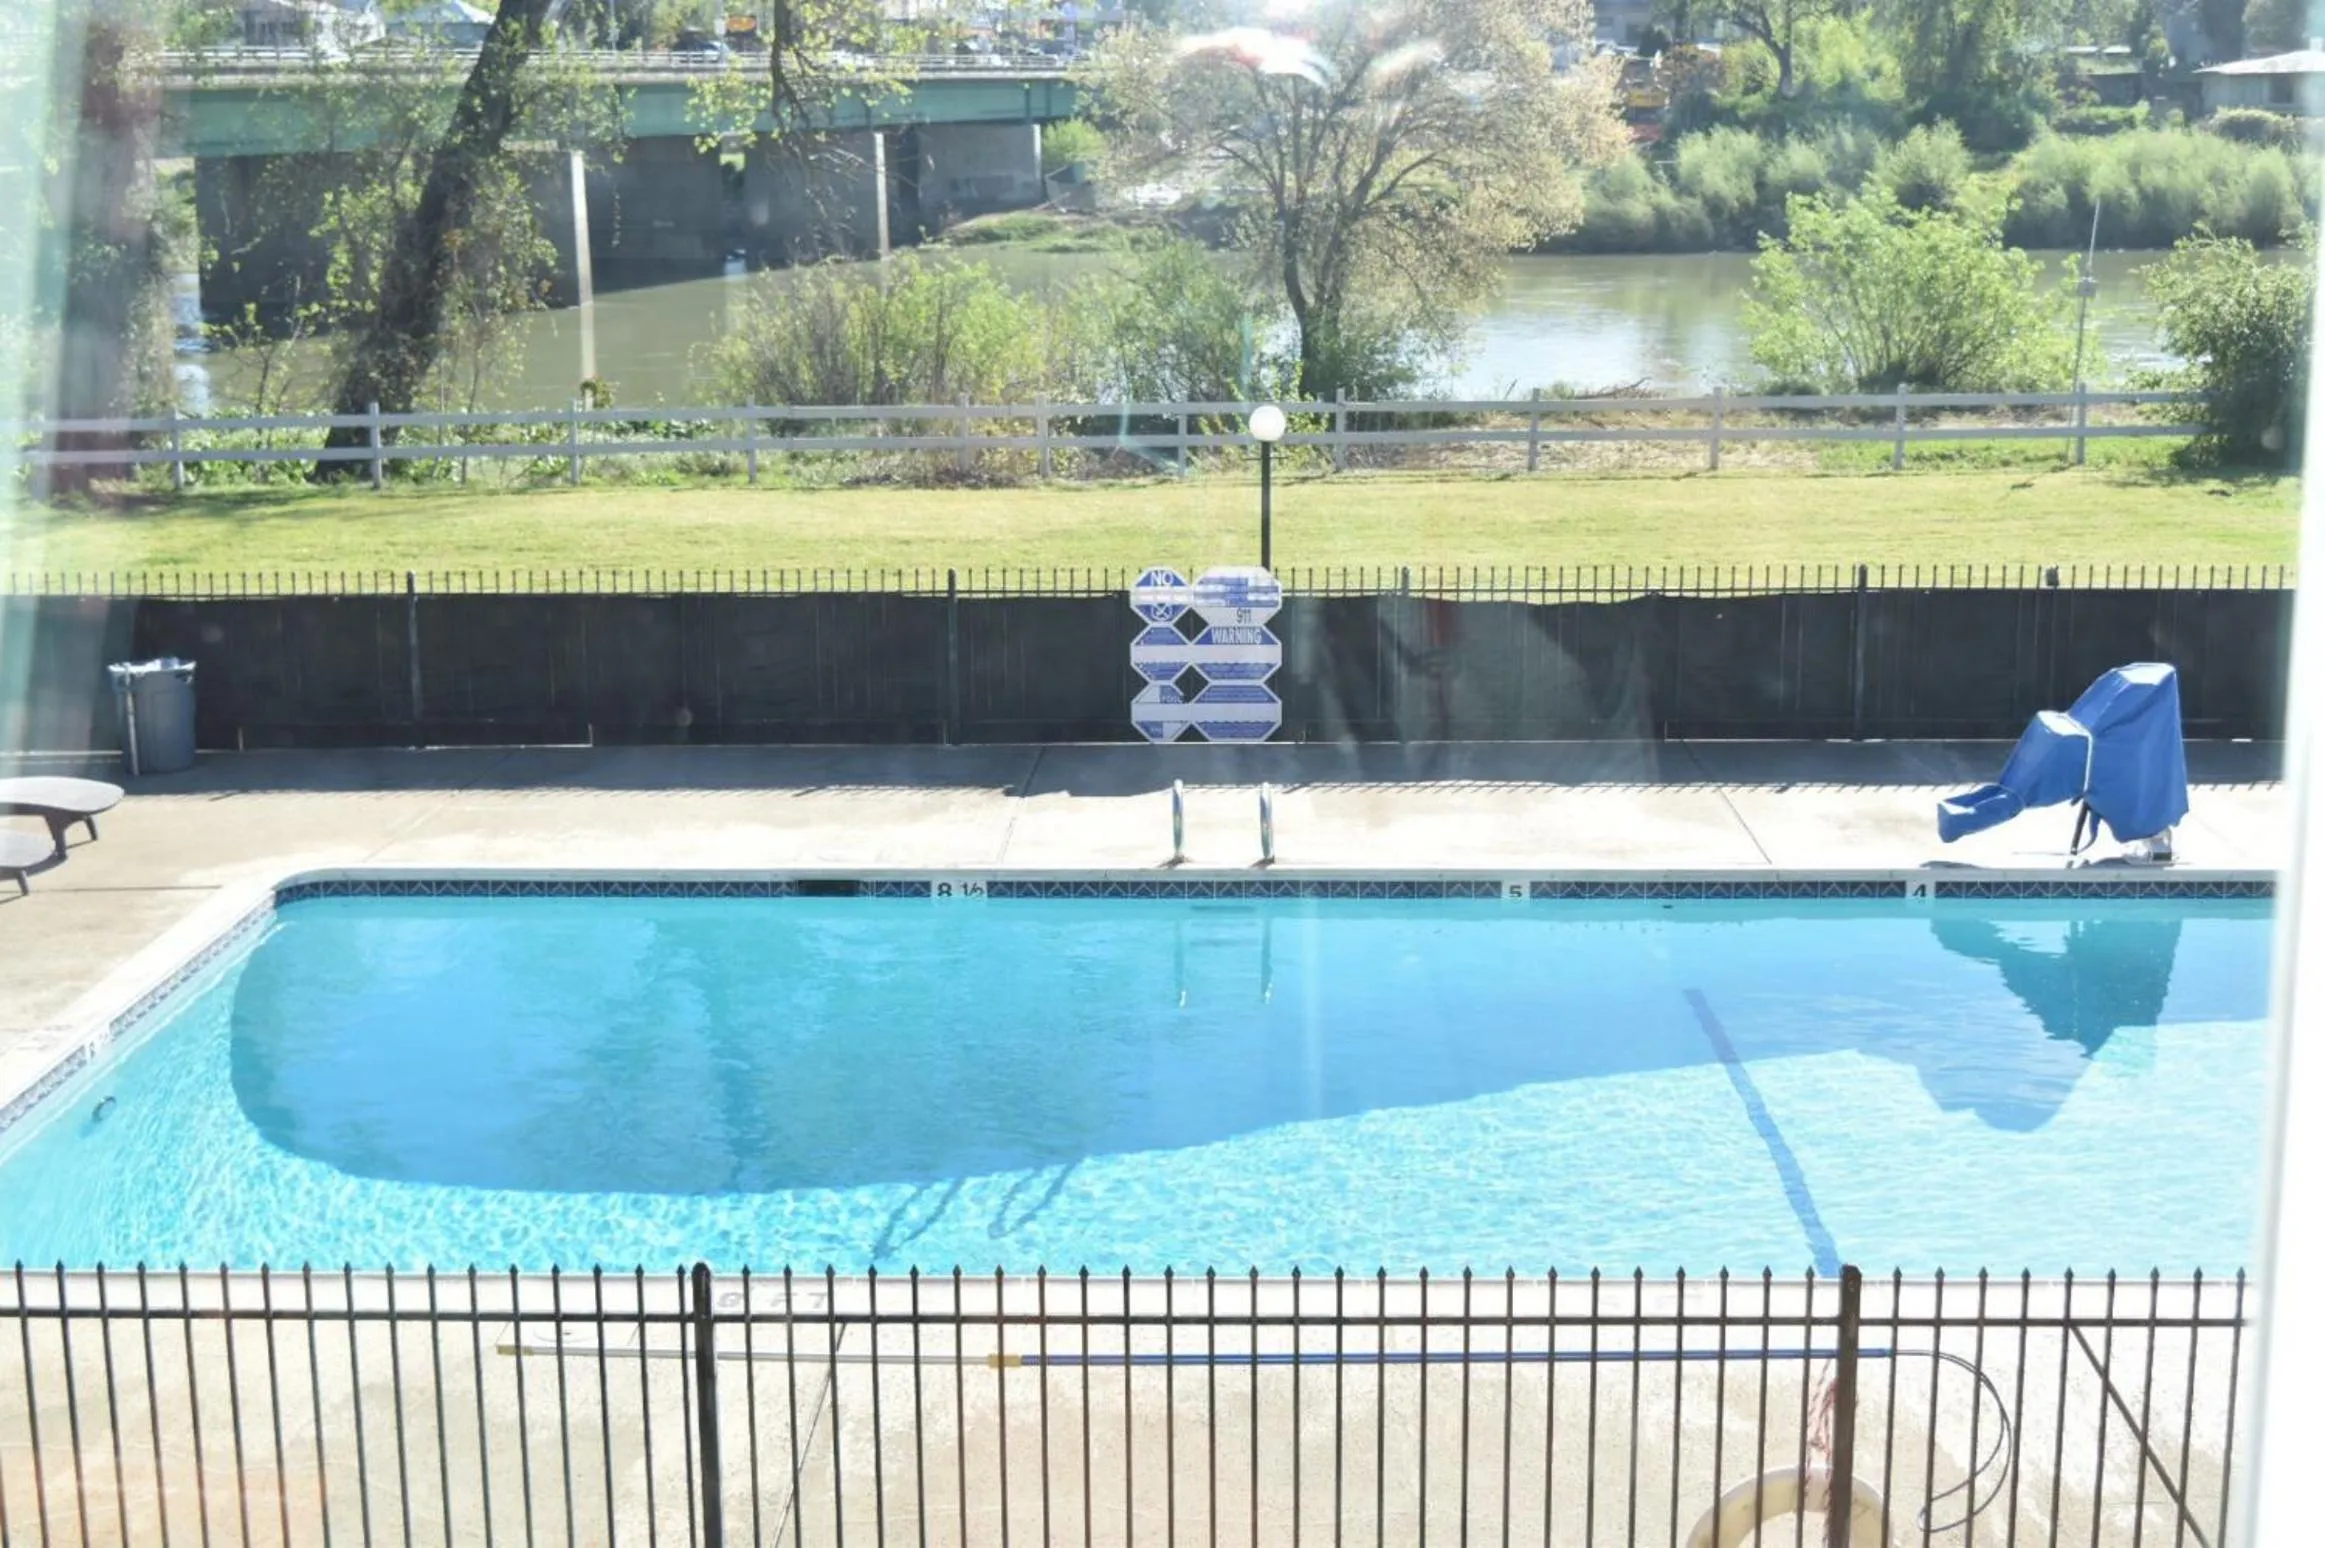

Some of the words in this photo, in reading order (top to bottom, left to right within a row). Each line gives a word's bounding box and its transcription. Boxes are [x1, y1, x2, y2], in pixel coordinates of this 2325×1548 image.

[1150, 571, 1174, 586] NO
[1236, 608, 1252, 624] 911
[1211, 627, 1262, 645] WARNING
[937, 882, 952, 897] 8
[1509, 885, 1522, 898] 5
[1912, 884, 1926, 898] 4
